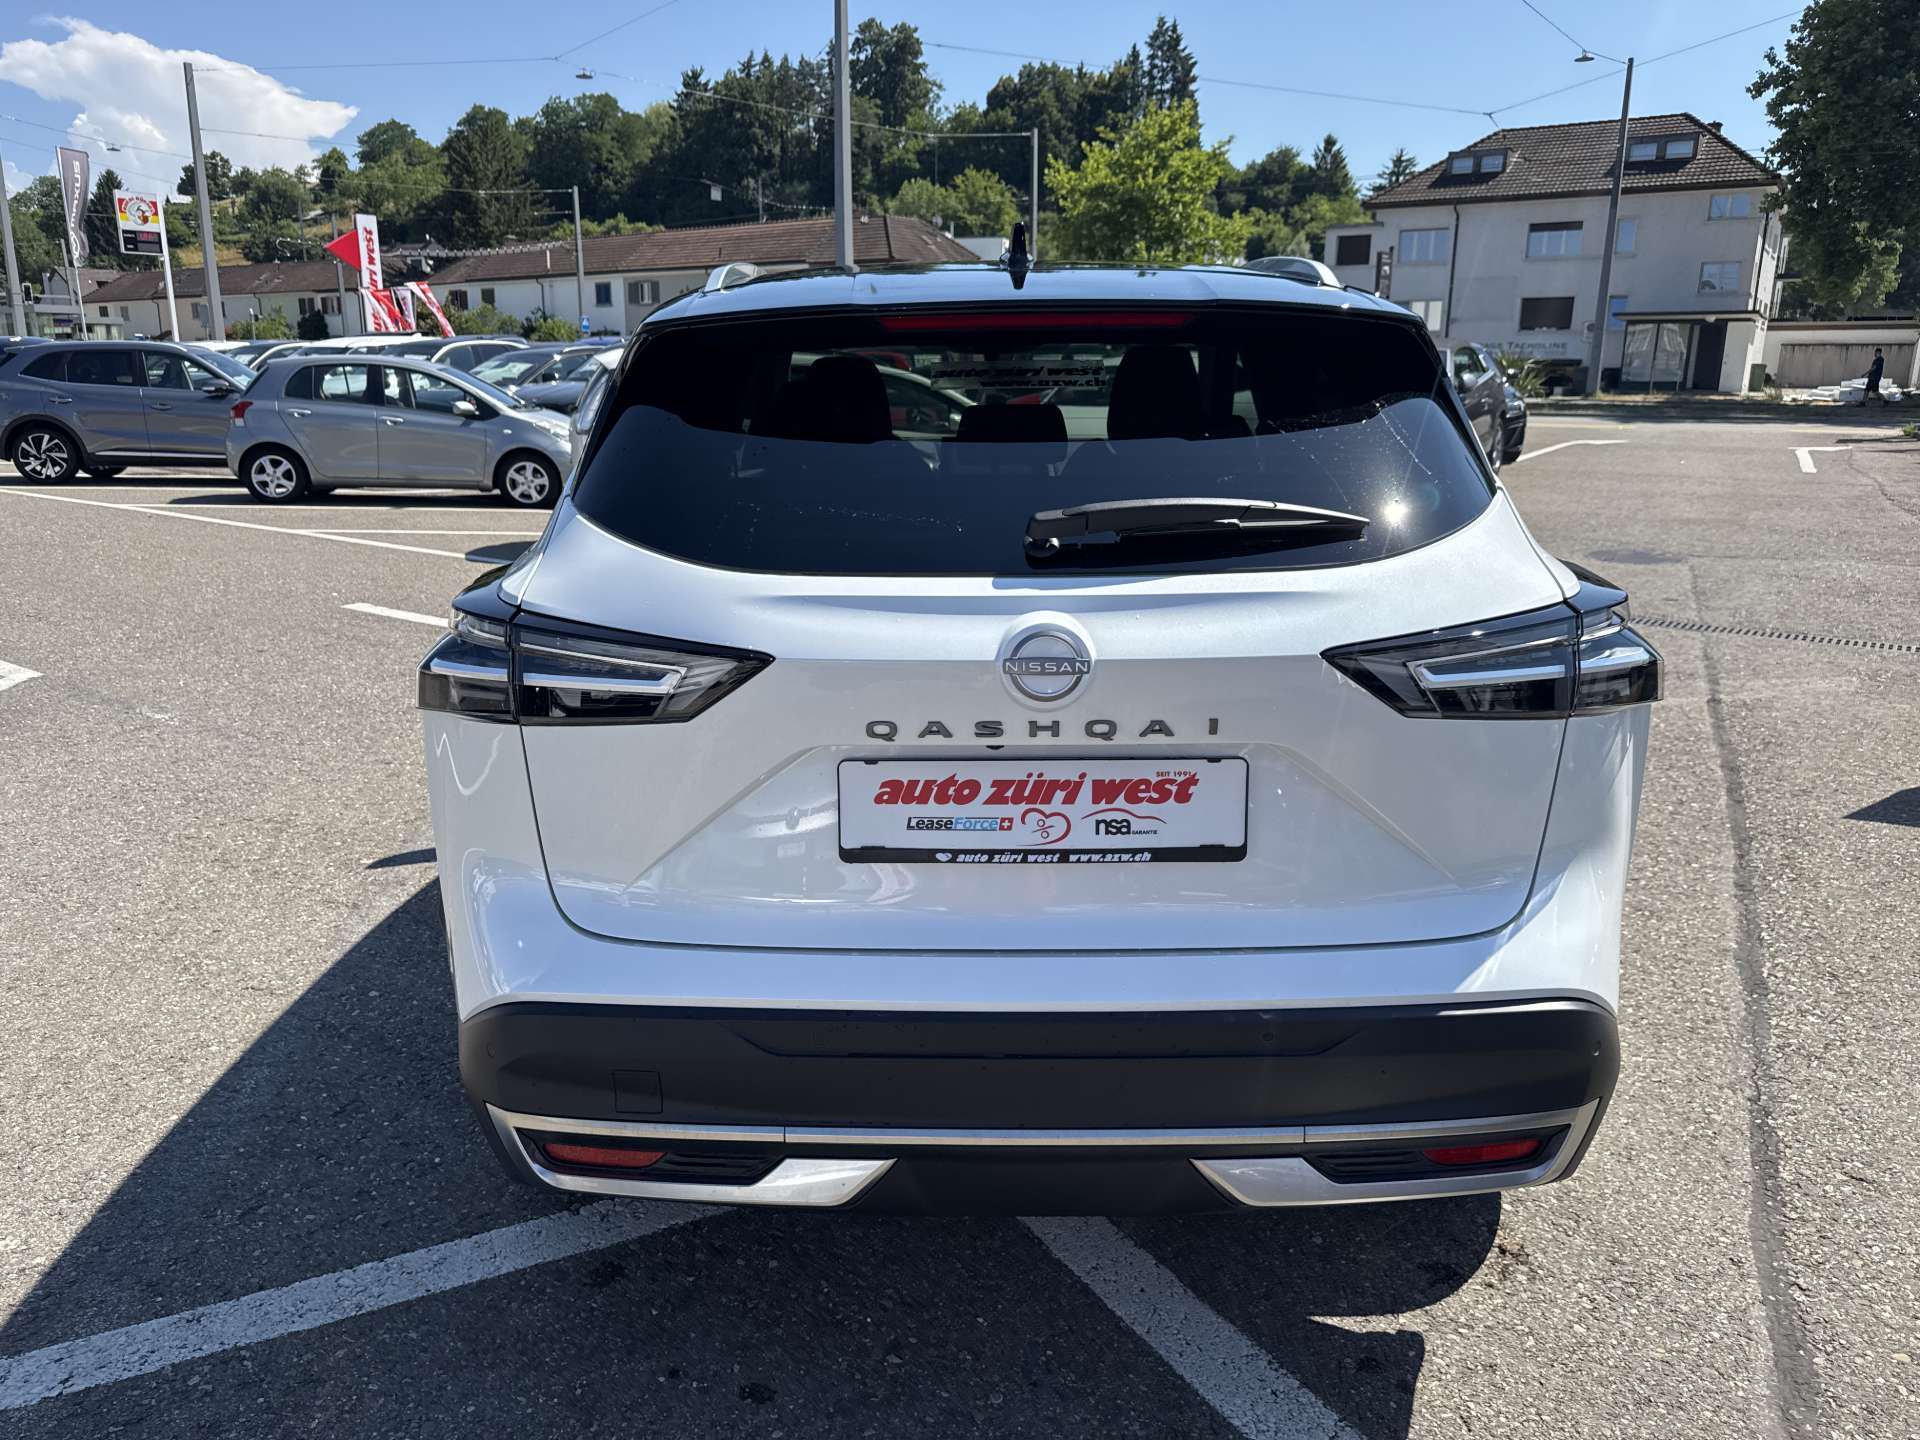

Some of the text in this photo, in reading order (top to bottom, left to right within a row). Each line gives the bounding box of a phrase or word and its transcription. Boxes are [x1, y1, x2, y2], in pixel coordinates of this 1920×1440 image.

[363, 226, 377, 266] west
[1048, 365, 1104, 376] west
[1005, 661, 1089, 673] NISSAN
[866, 718, 1219, 742] QASHQAI
[873, 771, 1200, 805] auto züri west
[906, 817, 999, 831] LeaseForce
[1095, 818, 1131, 836] nsa
[956, 851, 1152, 863] auto züri west www.azw.ch
